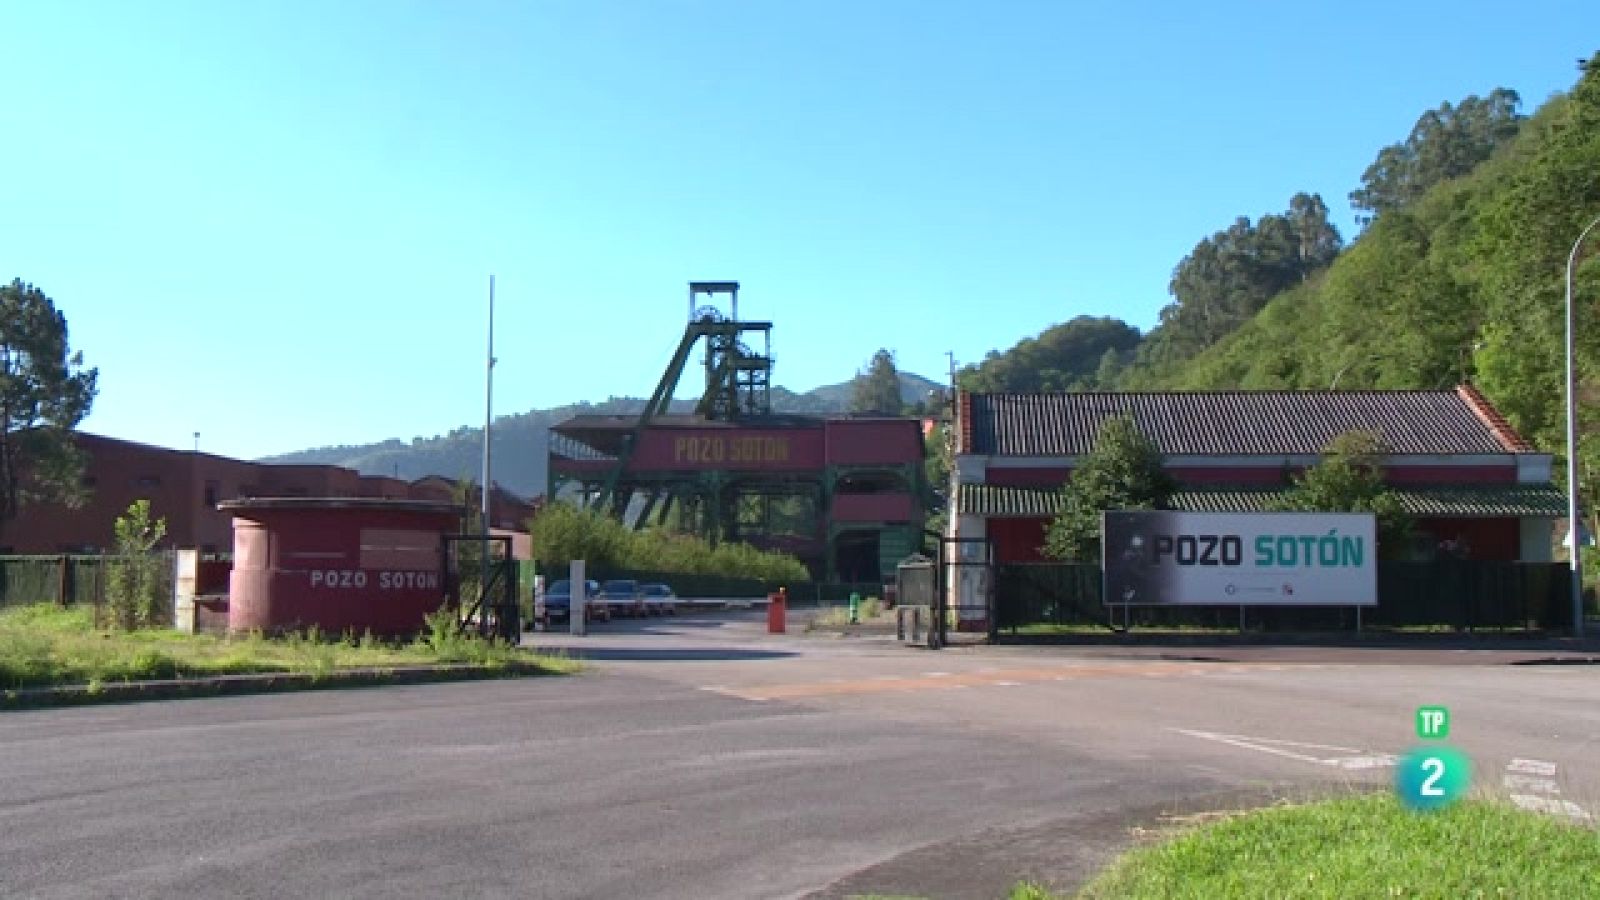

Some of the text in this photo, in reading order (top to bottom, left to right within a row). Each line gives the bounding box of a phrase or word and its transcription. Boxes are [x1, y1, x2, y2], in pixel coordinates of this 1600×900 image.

[674, 437, 722, 462] POZO
[1153, 528, 1363, 566] POZO SOTÓN
[310, 569, 438, 589] POZO SOTON
